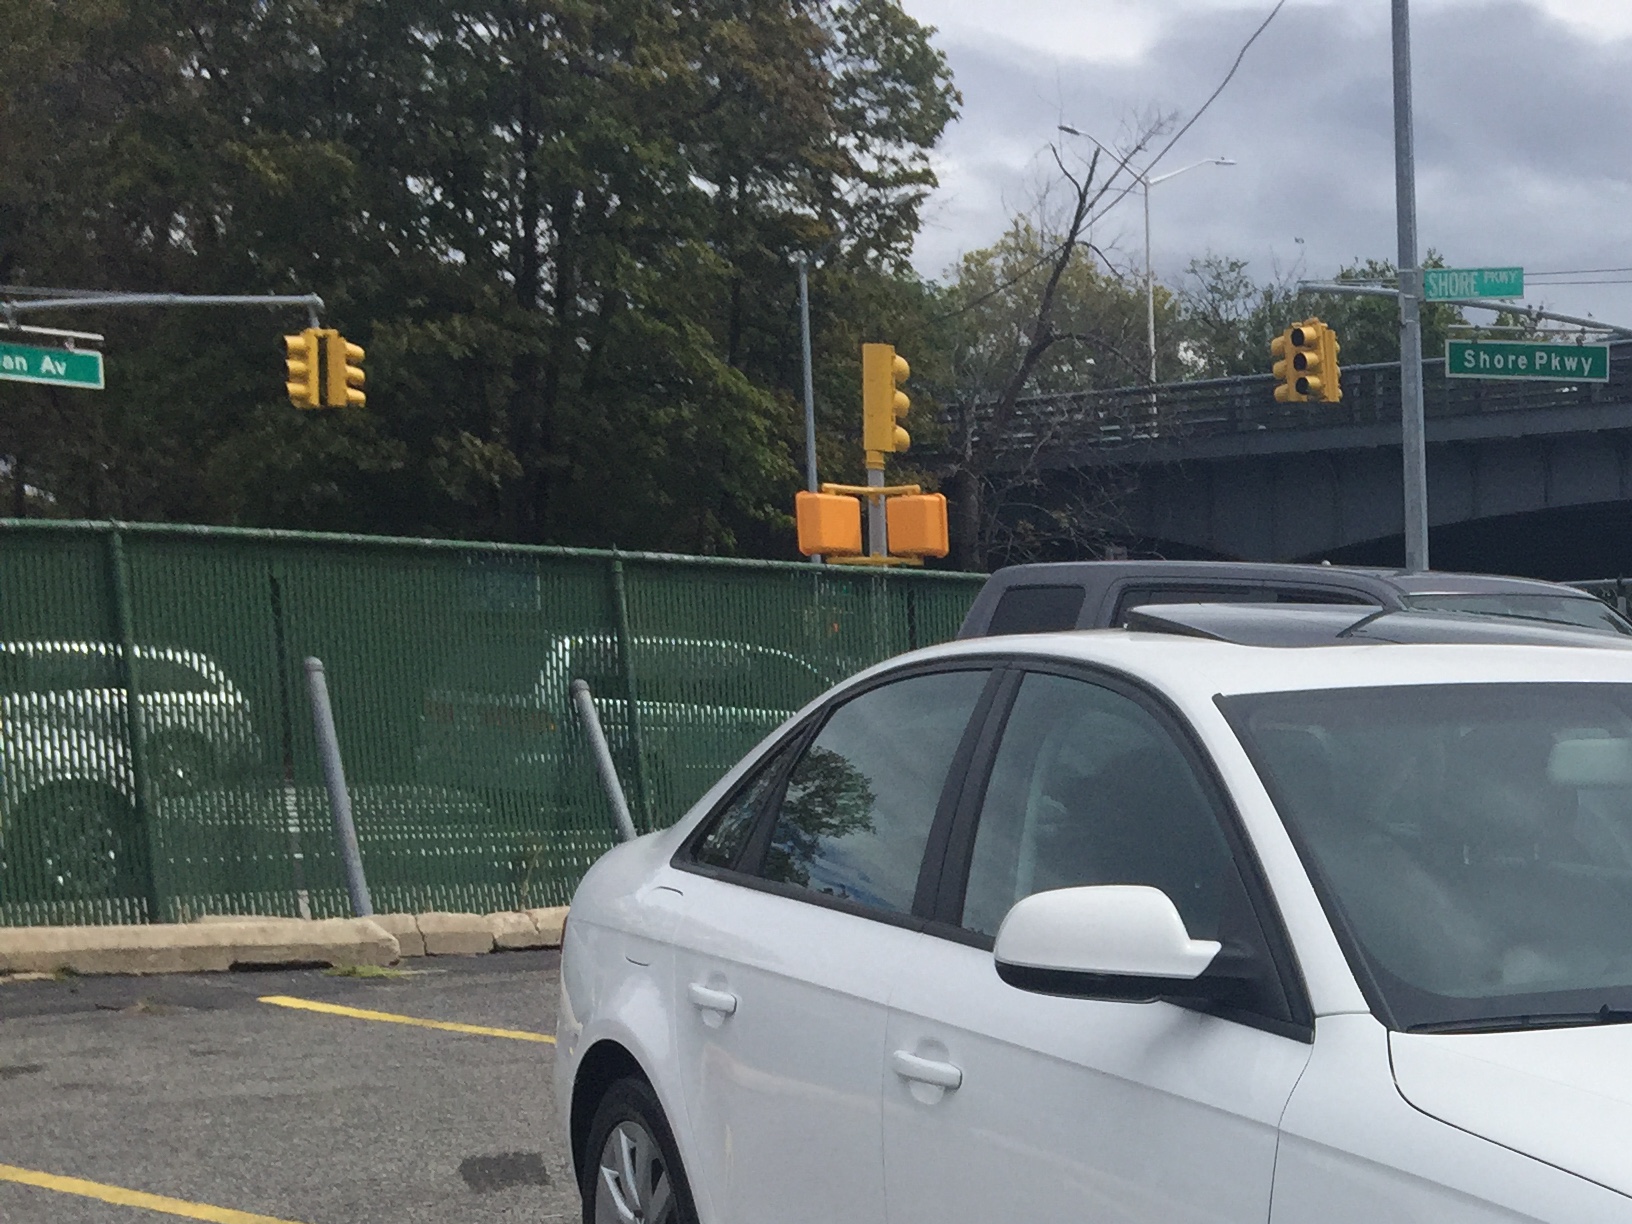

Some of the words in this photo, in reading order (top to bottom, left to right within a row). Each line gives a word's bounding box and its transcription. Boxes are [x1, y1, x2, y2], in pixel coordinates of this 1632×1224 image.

[1428, 271, 1480, 297] SHORE
[1483, 270, 1518, 284] PKWY
[40, 354, 67, 376] Av
[1463, 349, 1528, 370] Shore
[1534, 351, 1593, 377] Pkwy
